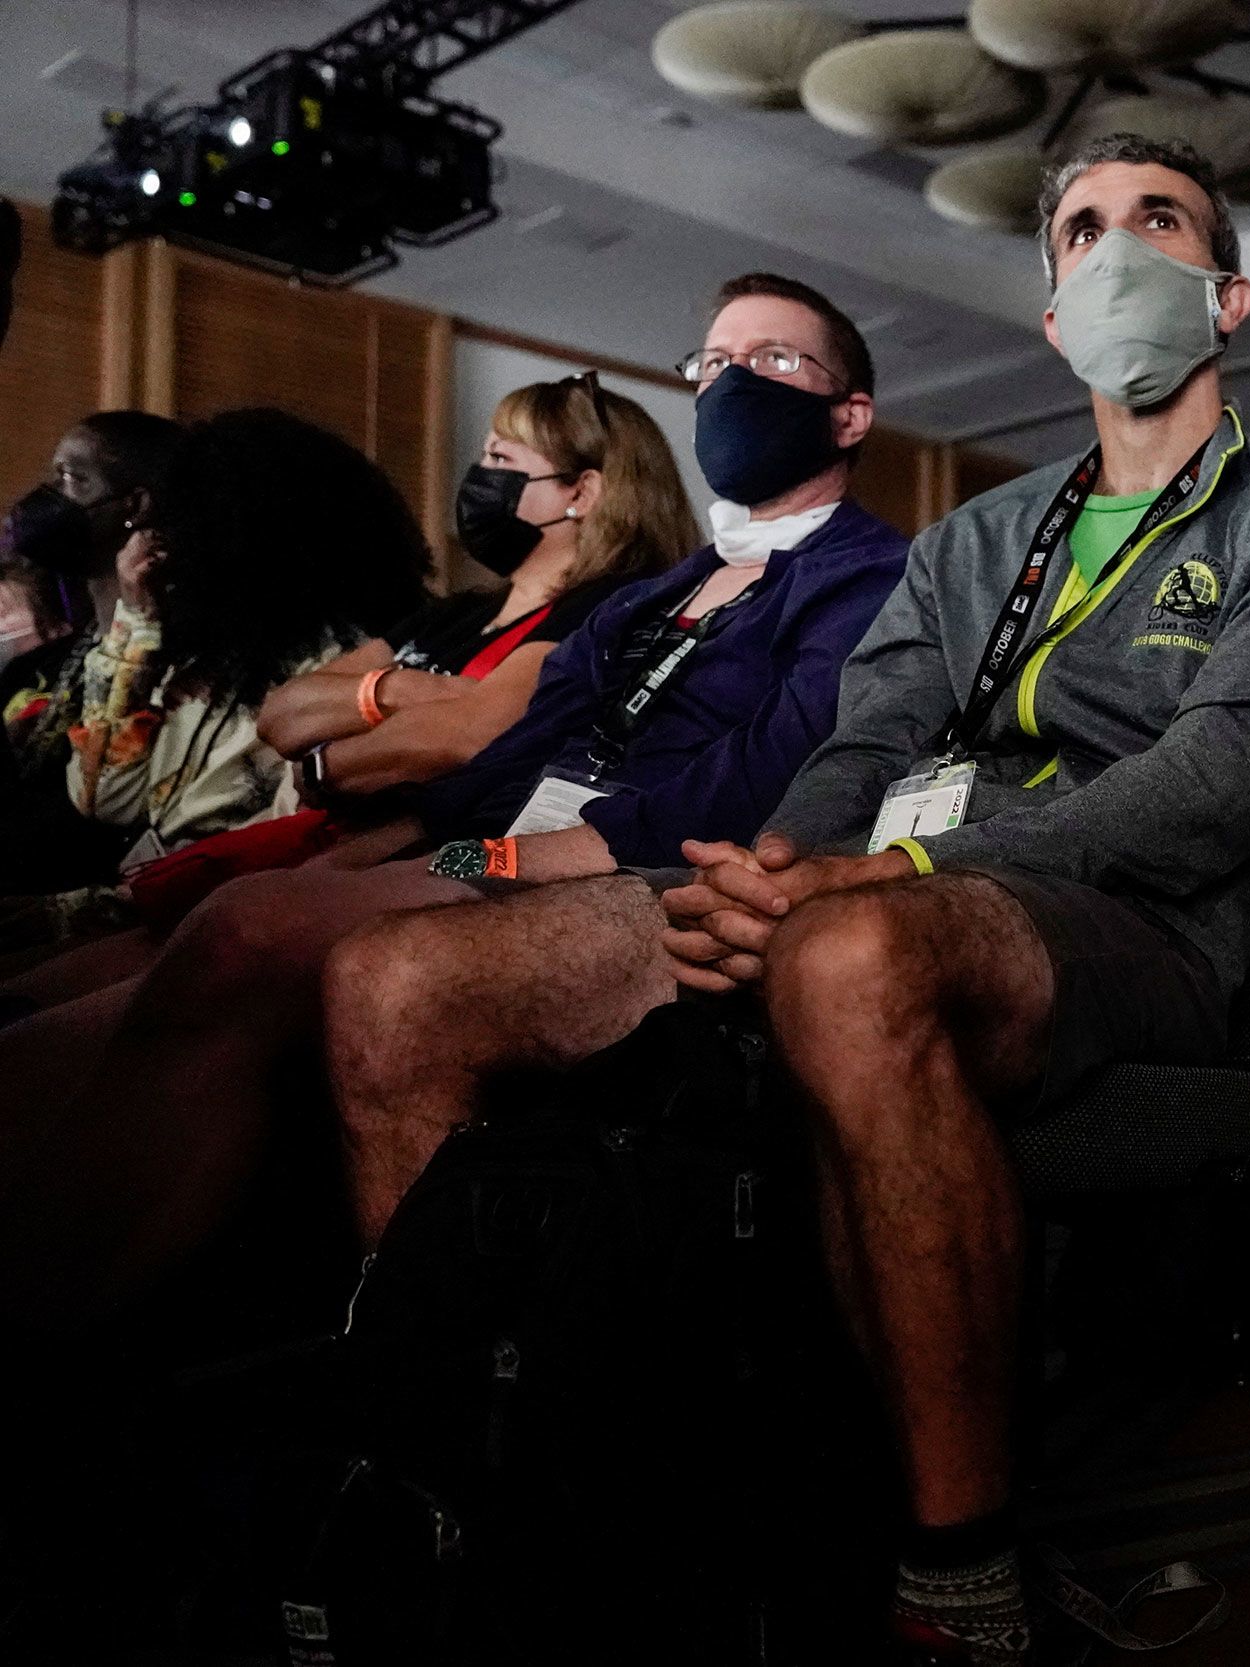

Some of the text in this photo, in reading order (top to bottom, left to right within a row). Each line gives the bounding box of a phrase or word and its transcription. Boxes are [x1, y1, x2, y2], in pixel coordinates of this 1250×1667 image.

[980, 674, 995, 693] S10
[989, 619, 1017, 671] OCTOBER
[1040, 507, 1070, 545] OCTOBER
[1184, 623, 1209, 636] CLUB
[1148, 633, 1172, 645] GOGO
[1172, 634, 1213, 654] CHALLENG
[952, 788, 964, 814] 2022
